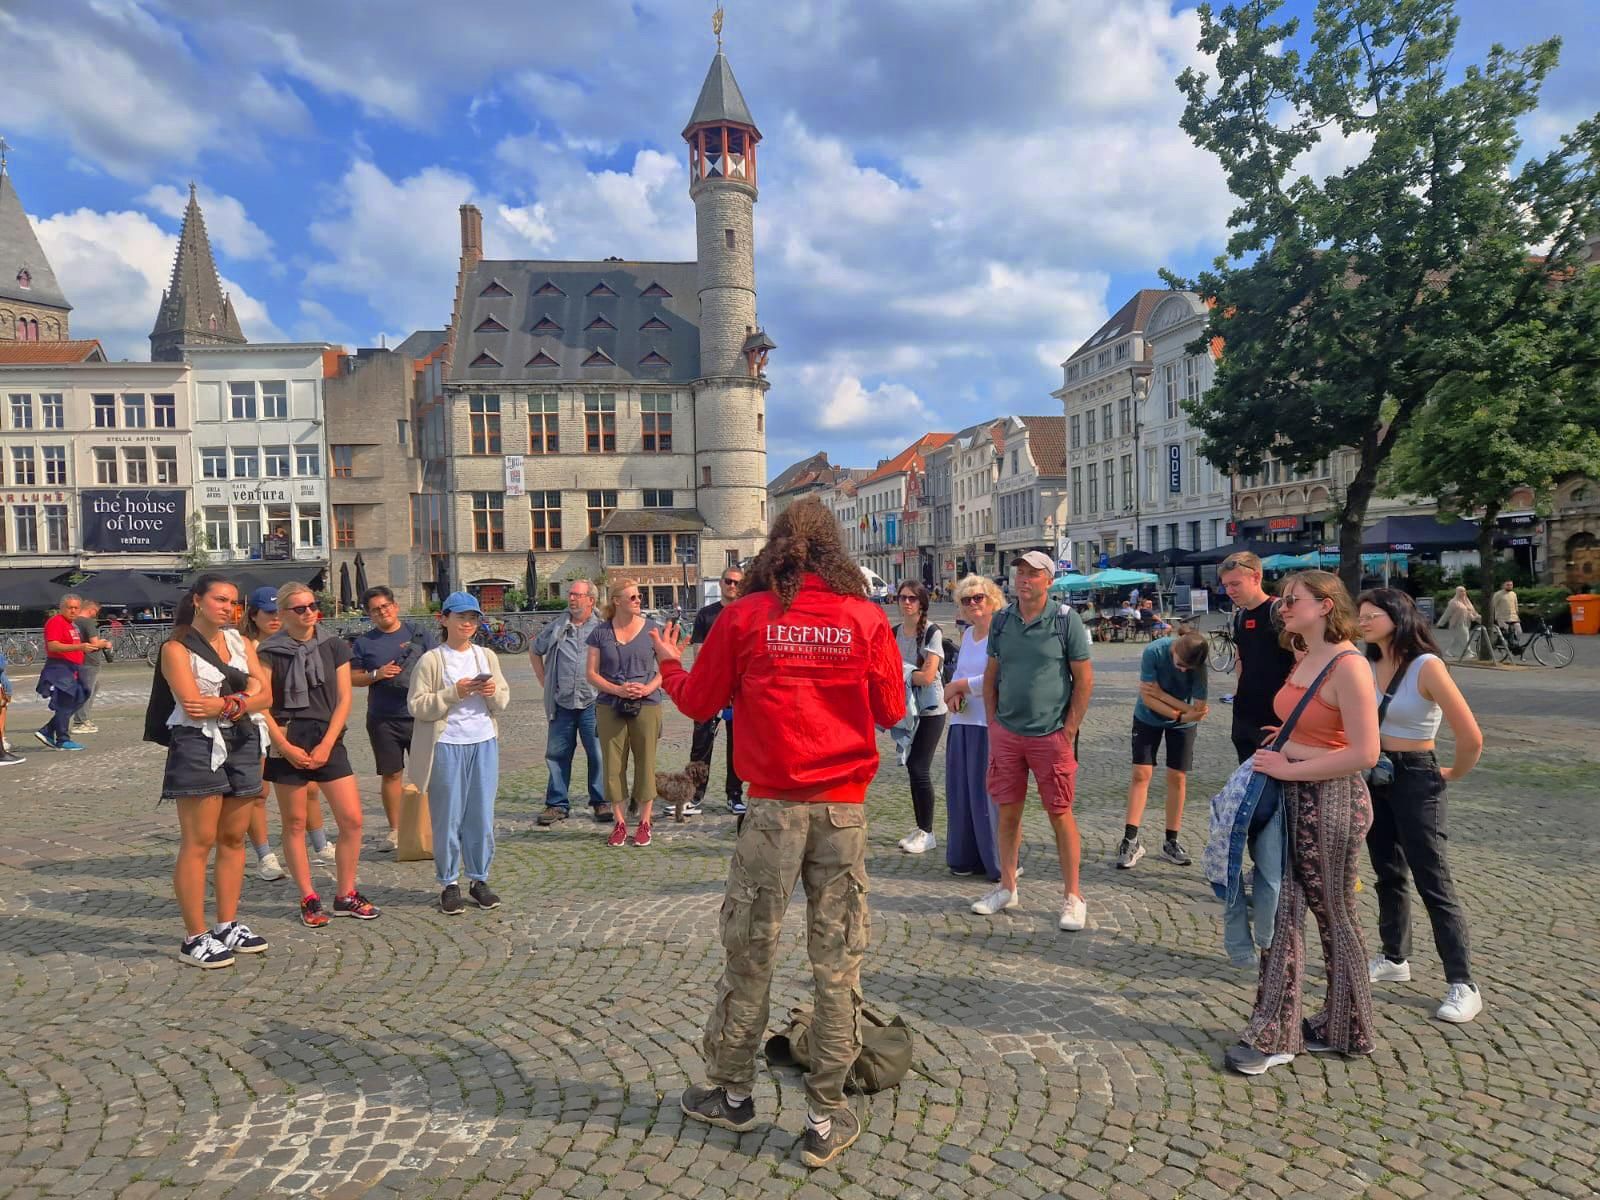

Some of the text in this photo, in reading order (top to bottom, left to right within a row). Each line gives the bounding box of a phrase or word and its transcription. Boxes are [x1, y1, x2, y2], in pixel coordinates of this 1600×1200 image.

[1171, 446, 1179, 486] ODE
[233, 488, 285, 501] ventura
[93, 497, 177, 514] the house
[106, 514, 164, 531] of love
[120, 536, 150, 545] ventura
[766, 625, 852, 644] LEGENDS
[805, 646, 852, 656] EXPERIENCES
